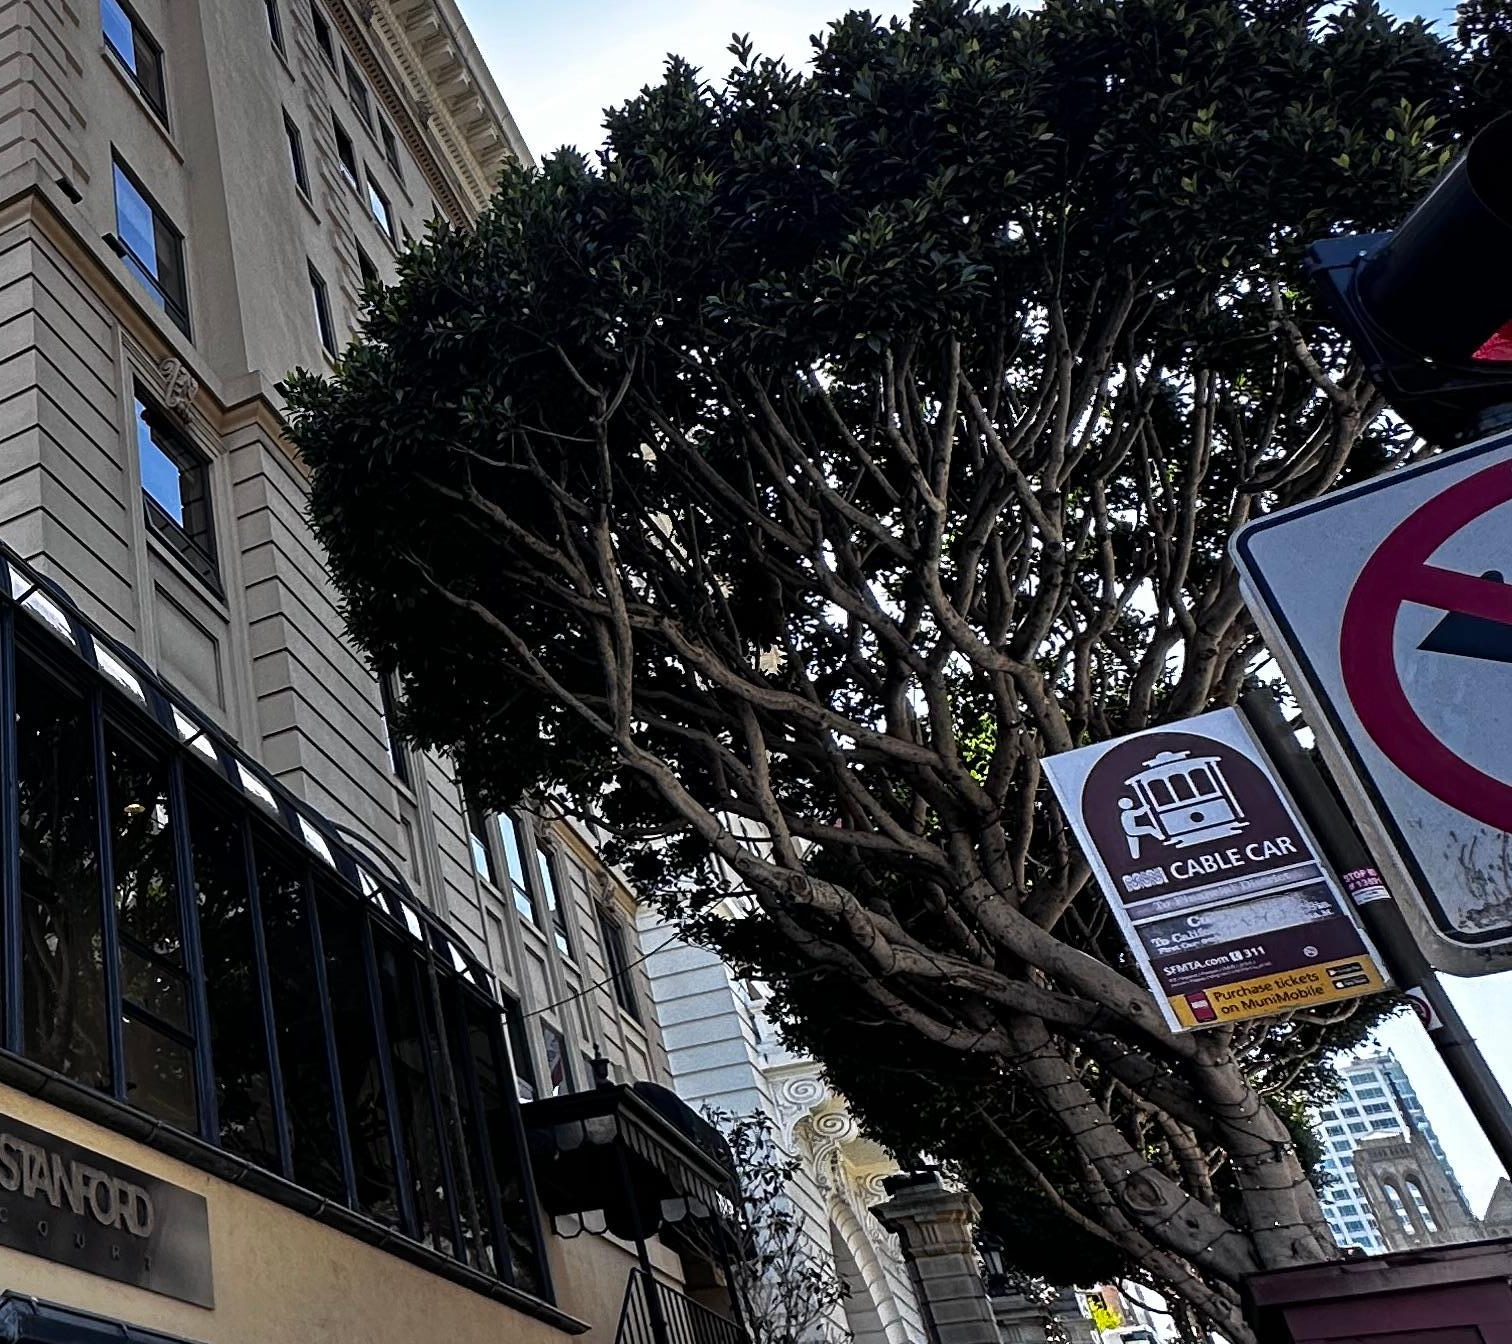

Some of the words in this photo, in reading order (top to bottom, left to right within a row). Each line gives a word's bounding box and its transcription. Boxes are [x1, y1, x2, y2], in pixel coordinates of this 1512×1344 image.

[1170, 848, 1245, 880] CABLE
[1246, 836, 1298, 861] CAR
[1343, 869, 1366, 883] STOP
[1163, 955, 1229, 976] SFMTA.com
[1243, 946, 1265, 958] 311
[1213, 982, 1273, 1002] Purchase
[1275, 971, 1319, 991] tickets
[1221, 1003, 1239, 1014] on
[1240, 986, 1325, 1010] MuniMobile
